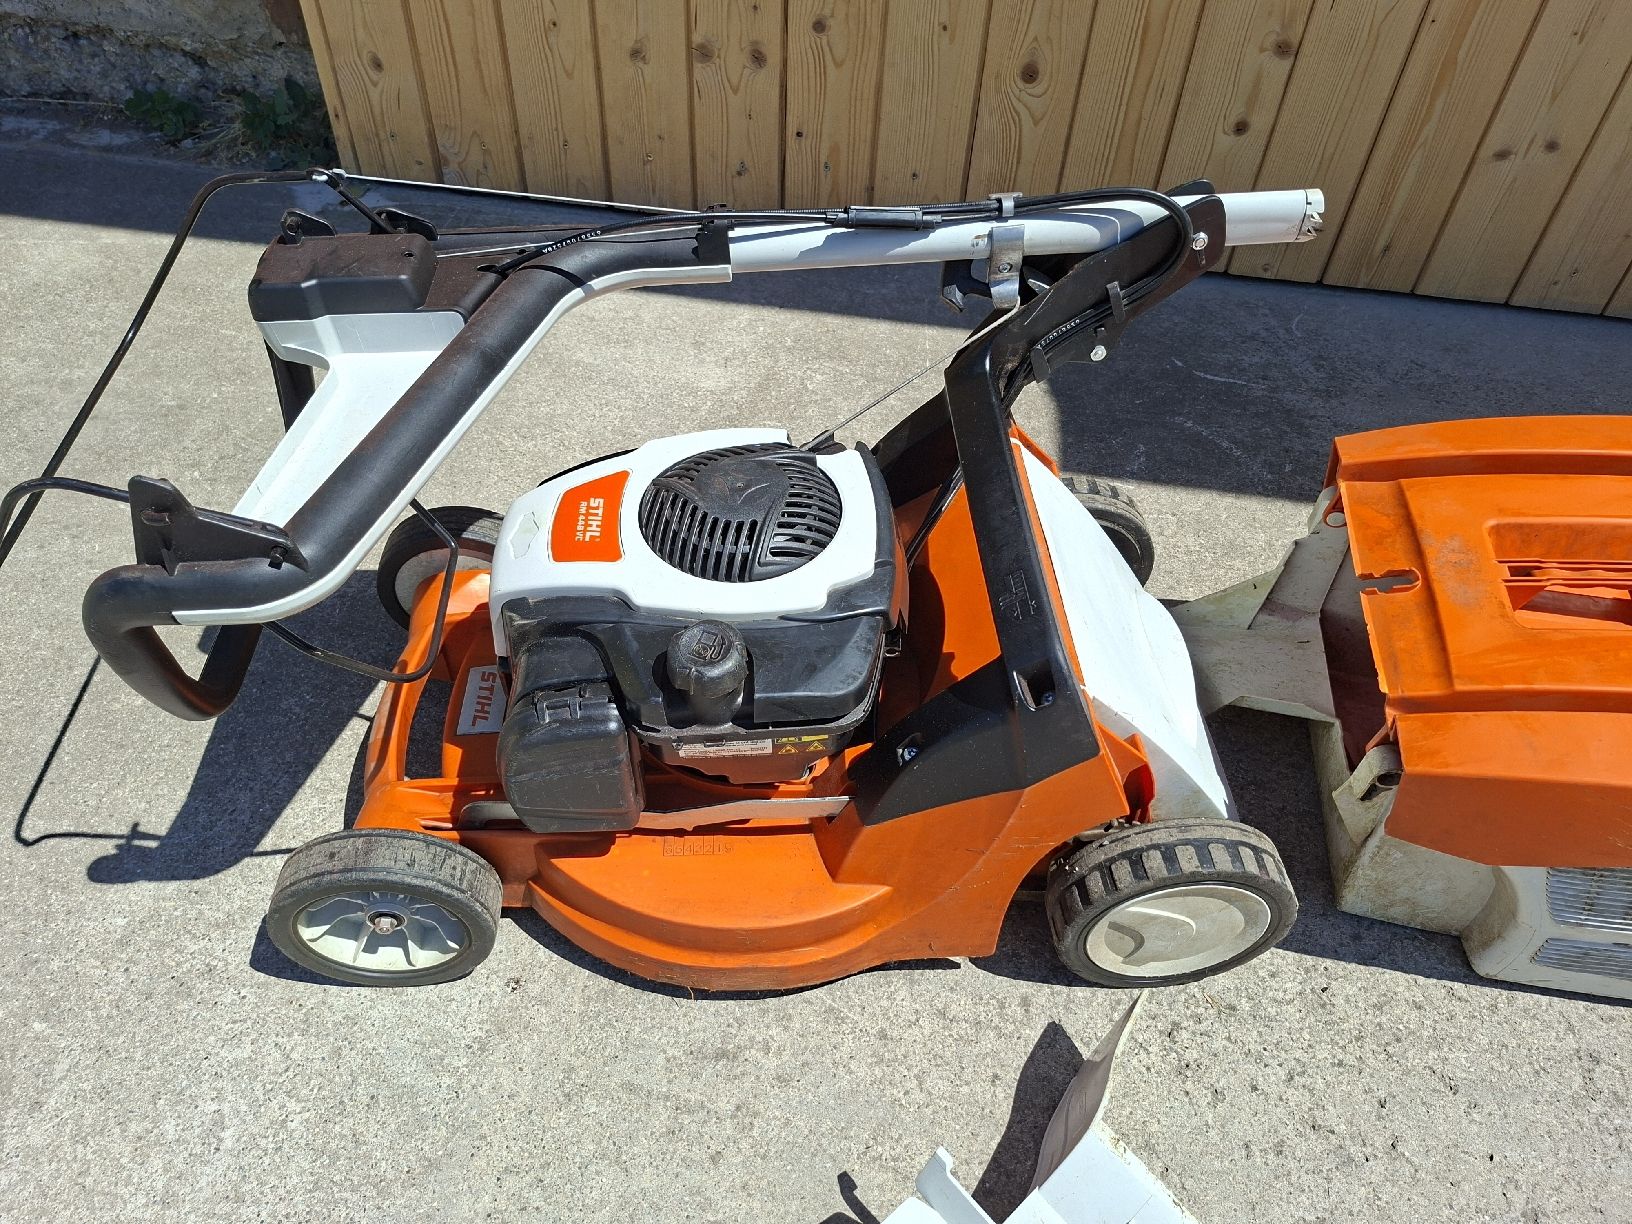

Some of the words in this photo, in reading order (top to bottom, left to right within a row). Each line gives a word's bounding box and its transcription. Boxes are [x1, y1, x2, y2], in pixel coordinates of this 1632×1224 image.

[578, 501, 588, 514] RM
[576, 515, 586, 531] 448
[584, 497, 605, 542] STIHL
[574, 531, 584, 542] VC
[471, 670, 498, 727] STIHL
